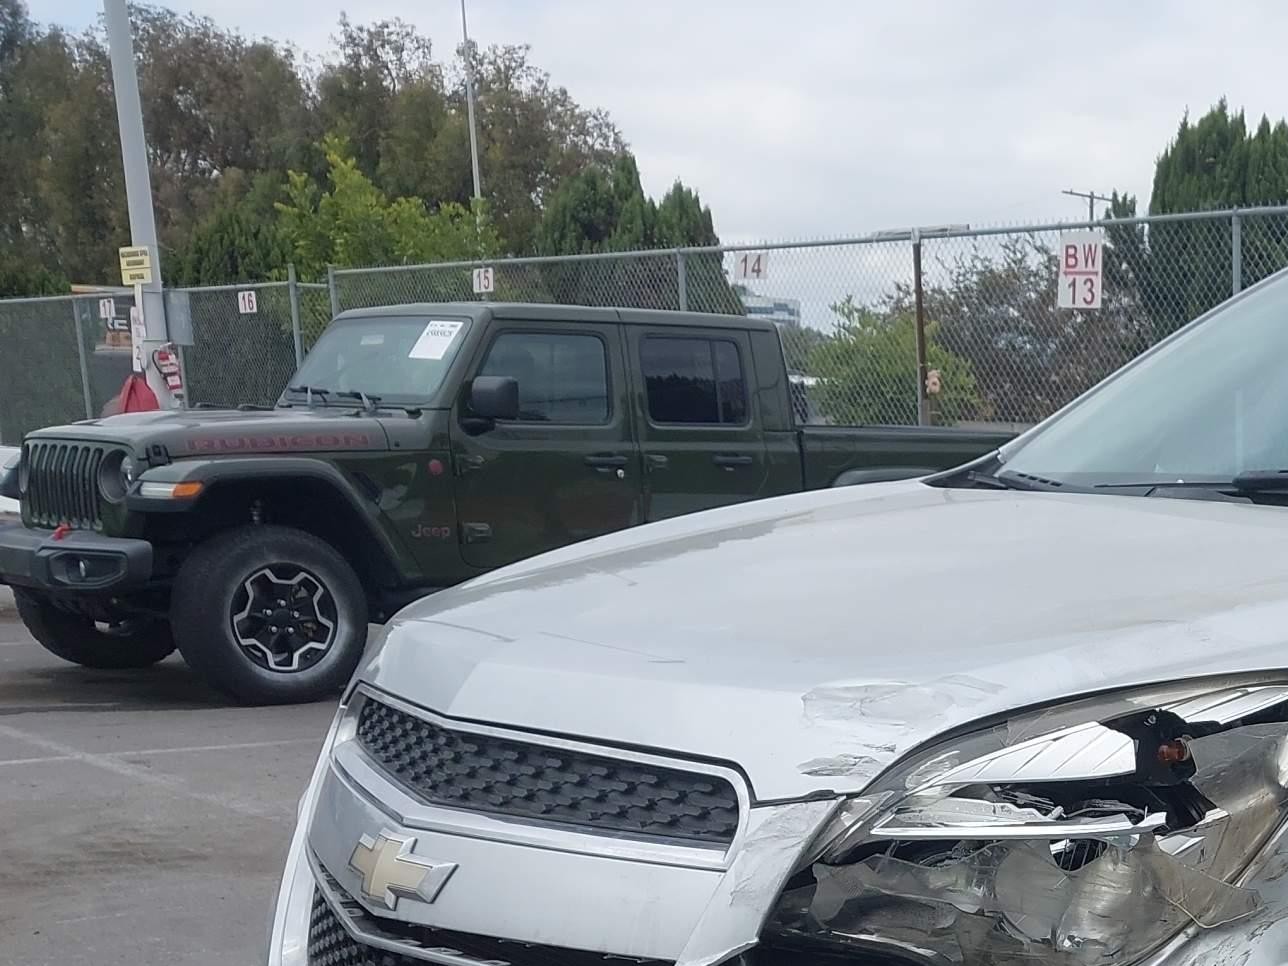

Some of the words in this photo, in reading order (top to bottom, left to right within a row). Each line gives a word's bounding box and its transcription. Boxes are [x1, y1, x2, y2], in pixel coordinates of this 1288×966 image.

[740, 254, 762, 279] 14
[1064, 243, 1098, 269] BW
[476, 269, 490, 290] 15
[1067, 277, 1096, 305] 13
[241, 292, 255, 313] 16
[185, 432, 369, 450] RUBICON
[411, 523, 450, 540] Jeep
